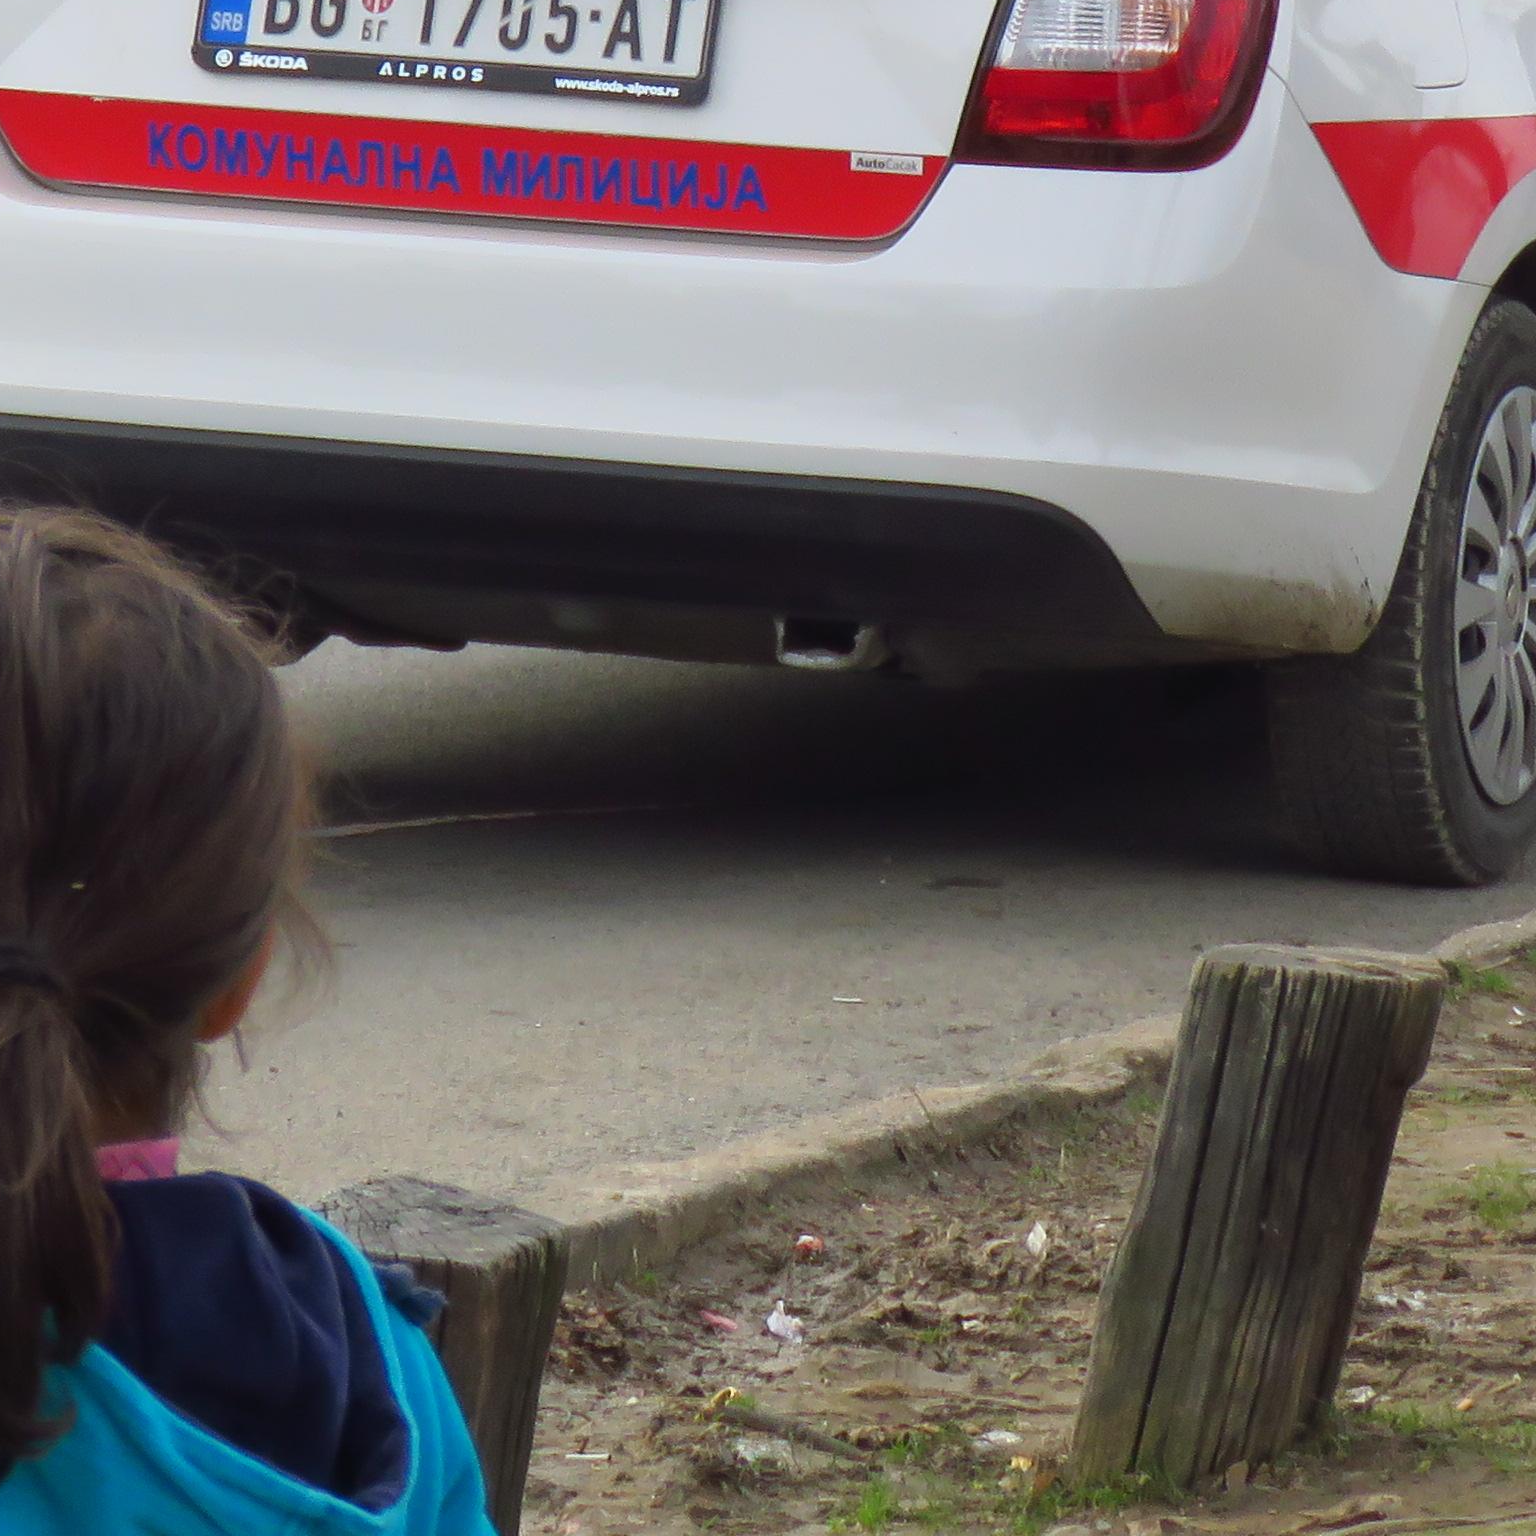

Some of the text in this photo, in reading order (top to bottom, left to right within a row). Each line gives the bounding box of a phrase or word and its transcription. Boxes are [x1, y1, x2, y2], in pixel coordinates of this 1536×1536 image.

[210, 11, 243, 33] SRB
[239, 51, 680, 98] ŠKODA ALPROS www.skoda-alpros.rs
[147, 121, 768, 212] КОМУНАЛНА МИЛИЦИЈА
